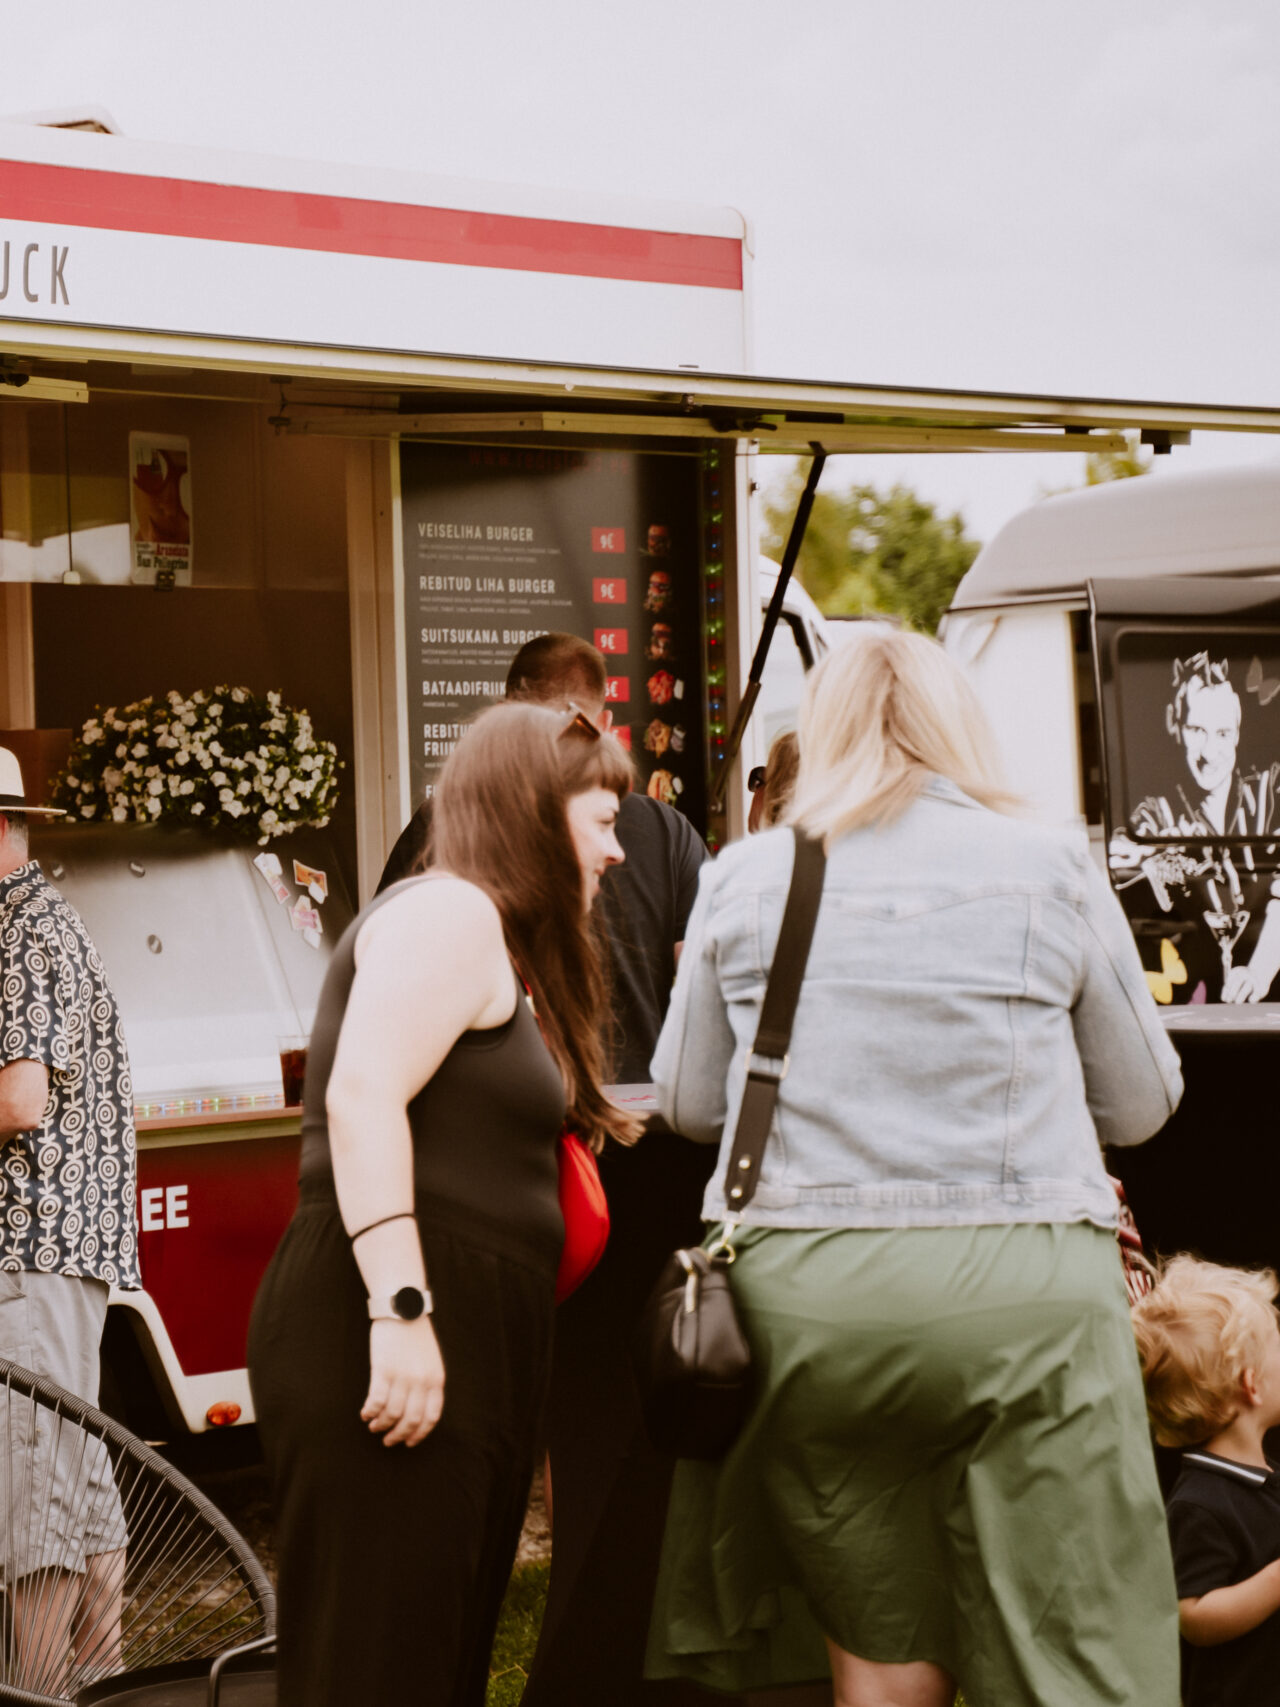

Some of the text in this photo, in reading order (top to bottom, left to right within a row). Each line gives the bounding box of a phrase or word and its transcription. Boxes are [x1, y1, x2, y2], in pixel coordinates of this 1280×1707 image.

[418, 522, 534, 542] VEISELIHA BURGER
[420, 575, 556, 594] REBITUD LIHA BURGER
[600, 583, 615, 600] 9€
[421, 627, 499, 644] SUITSUKANA
[600, 633, 616, 651] 9€
